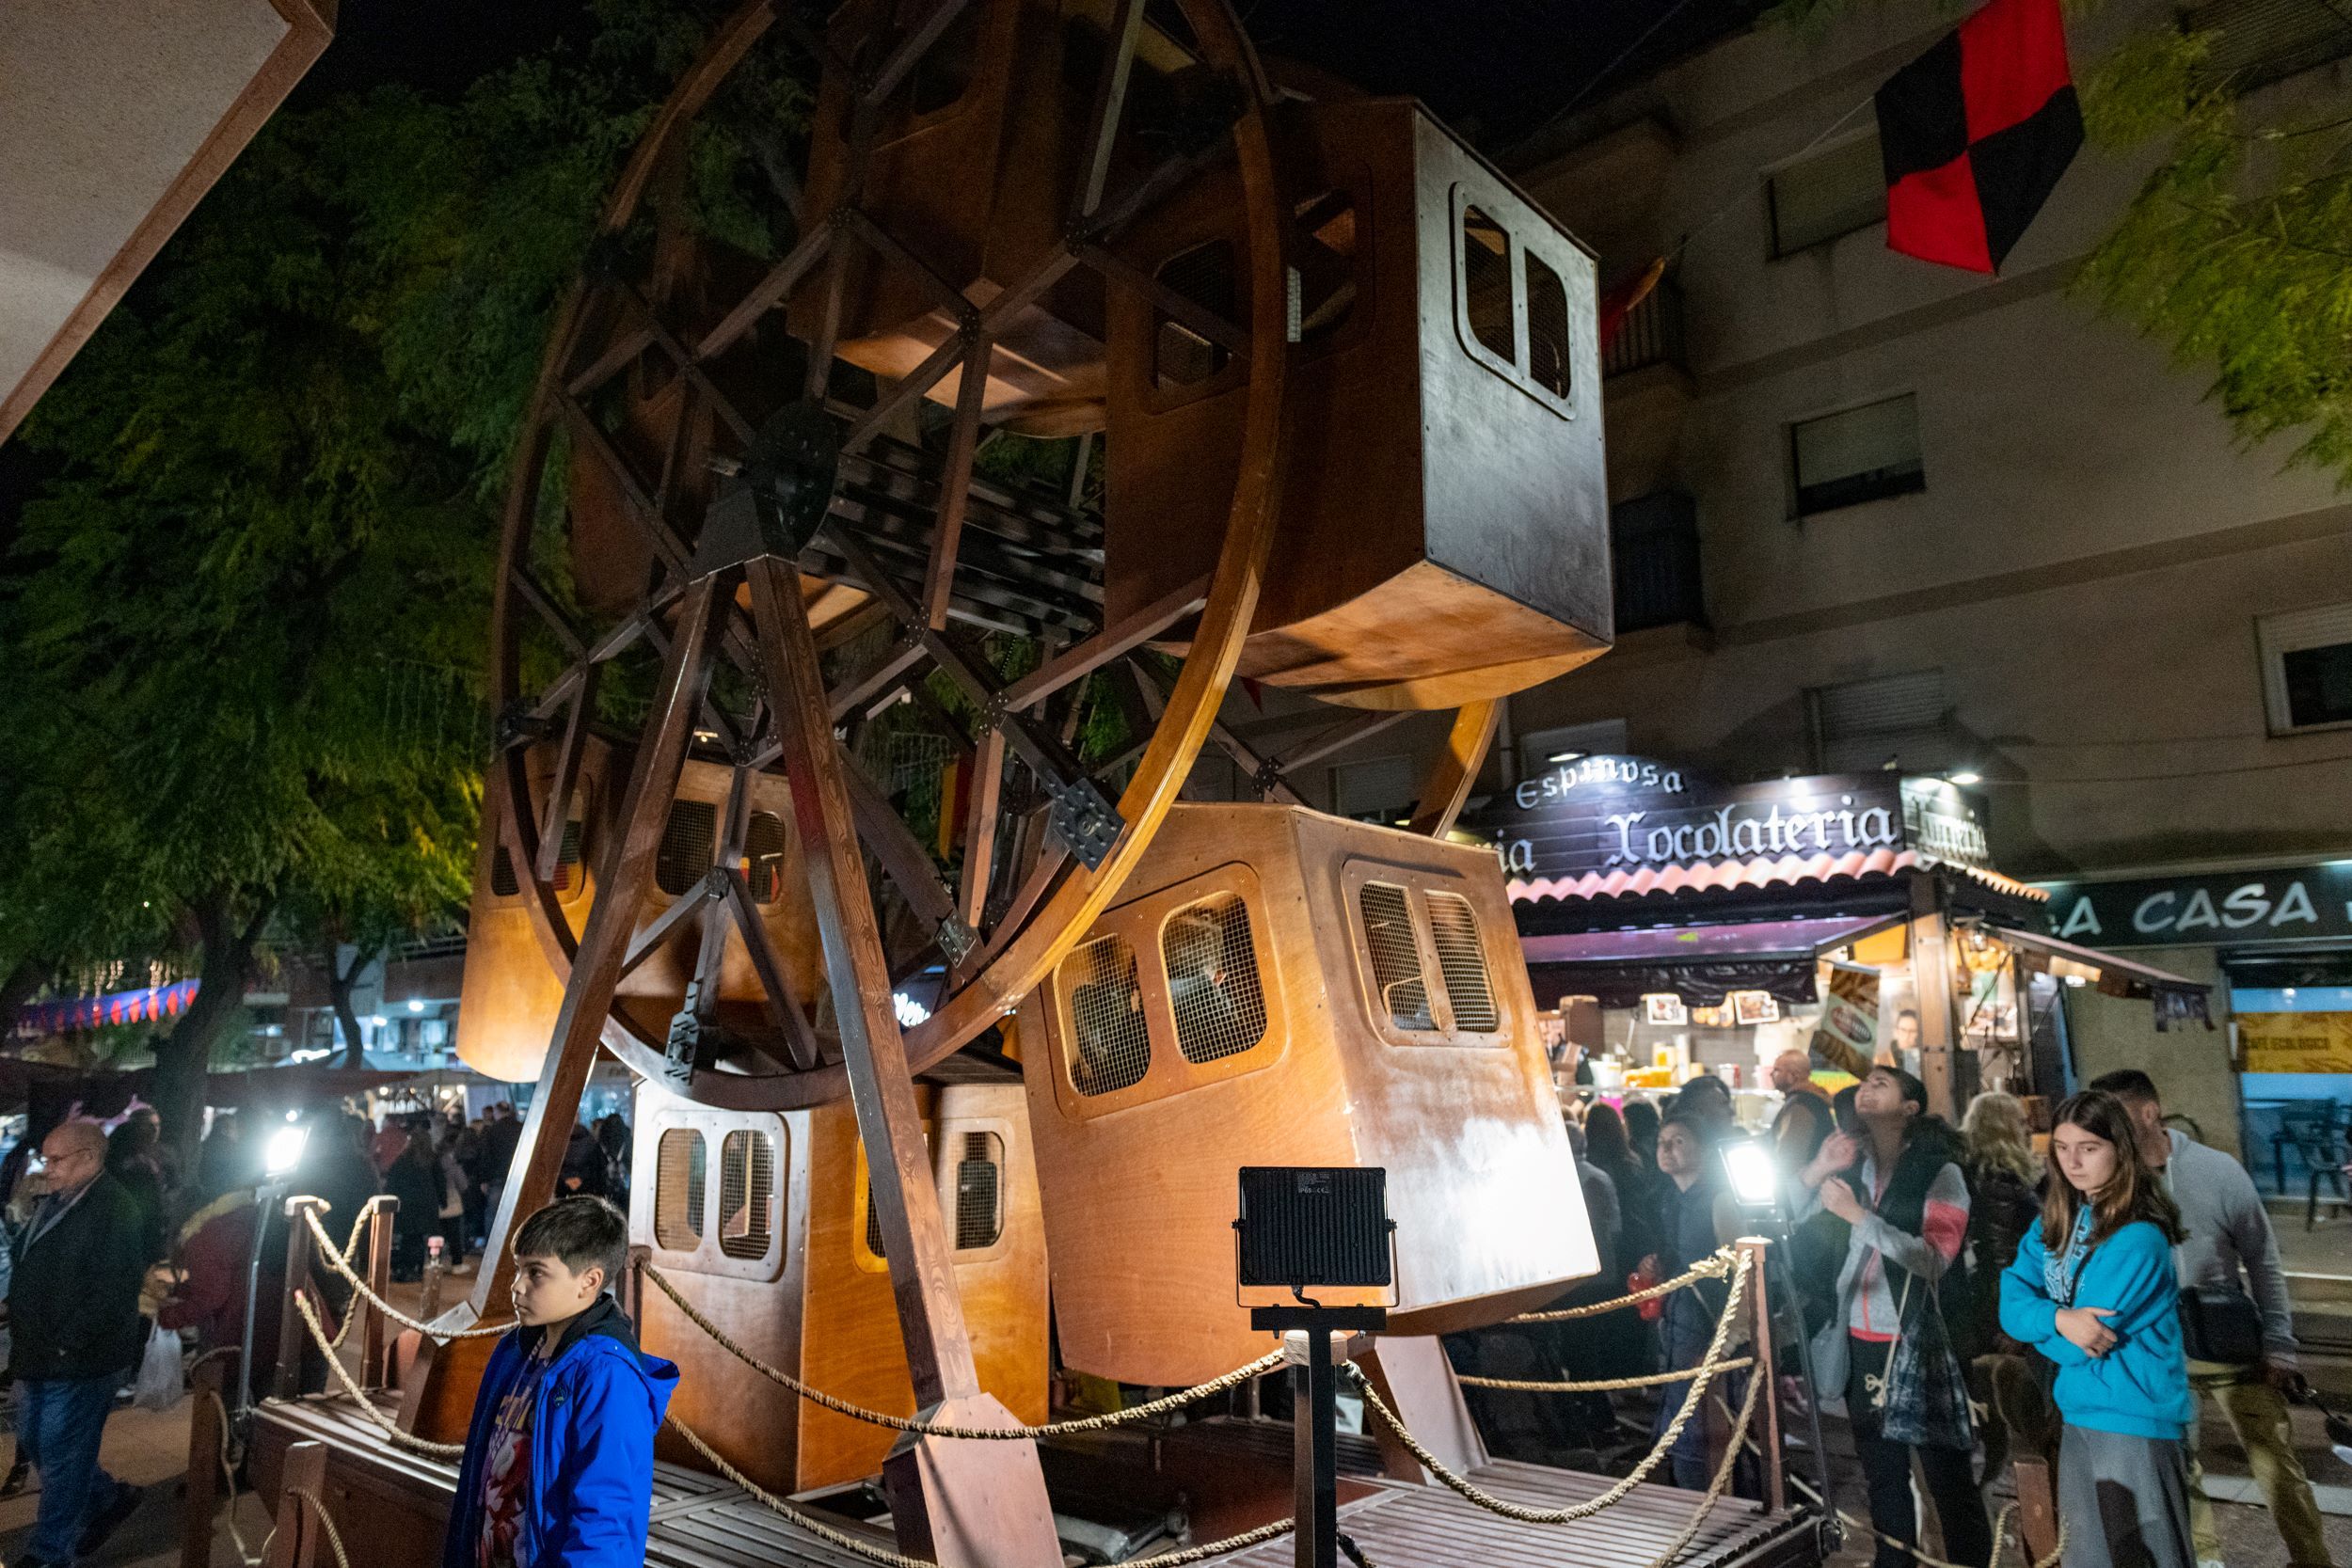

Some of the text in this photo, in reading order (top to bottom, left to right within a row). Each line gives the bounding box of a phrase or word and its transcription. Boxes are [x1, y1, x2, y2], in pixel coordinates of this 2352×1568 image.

[1516, 757, 1684, 809] Espinosa
[1481, 795, 1897, 873] ia Xocolateria
[2047, 896, 2102, 939] A
[2133, 881, 2318, 933] CASA
